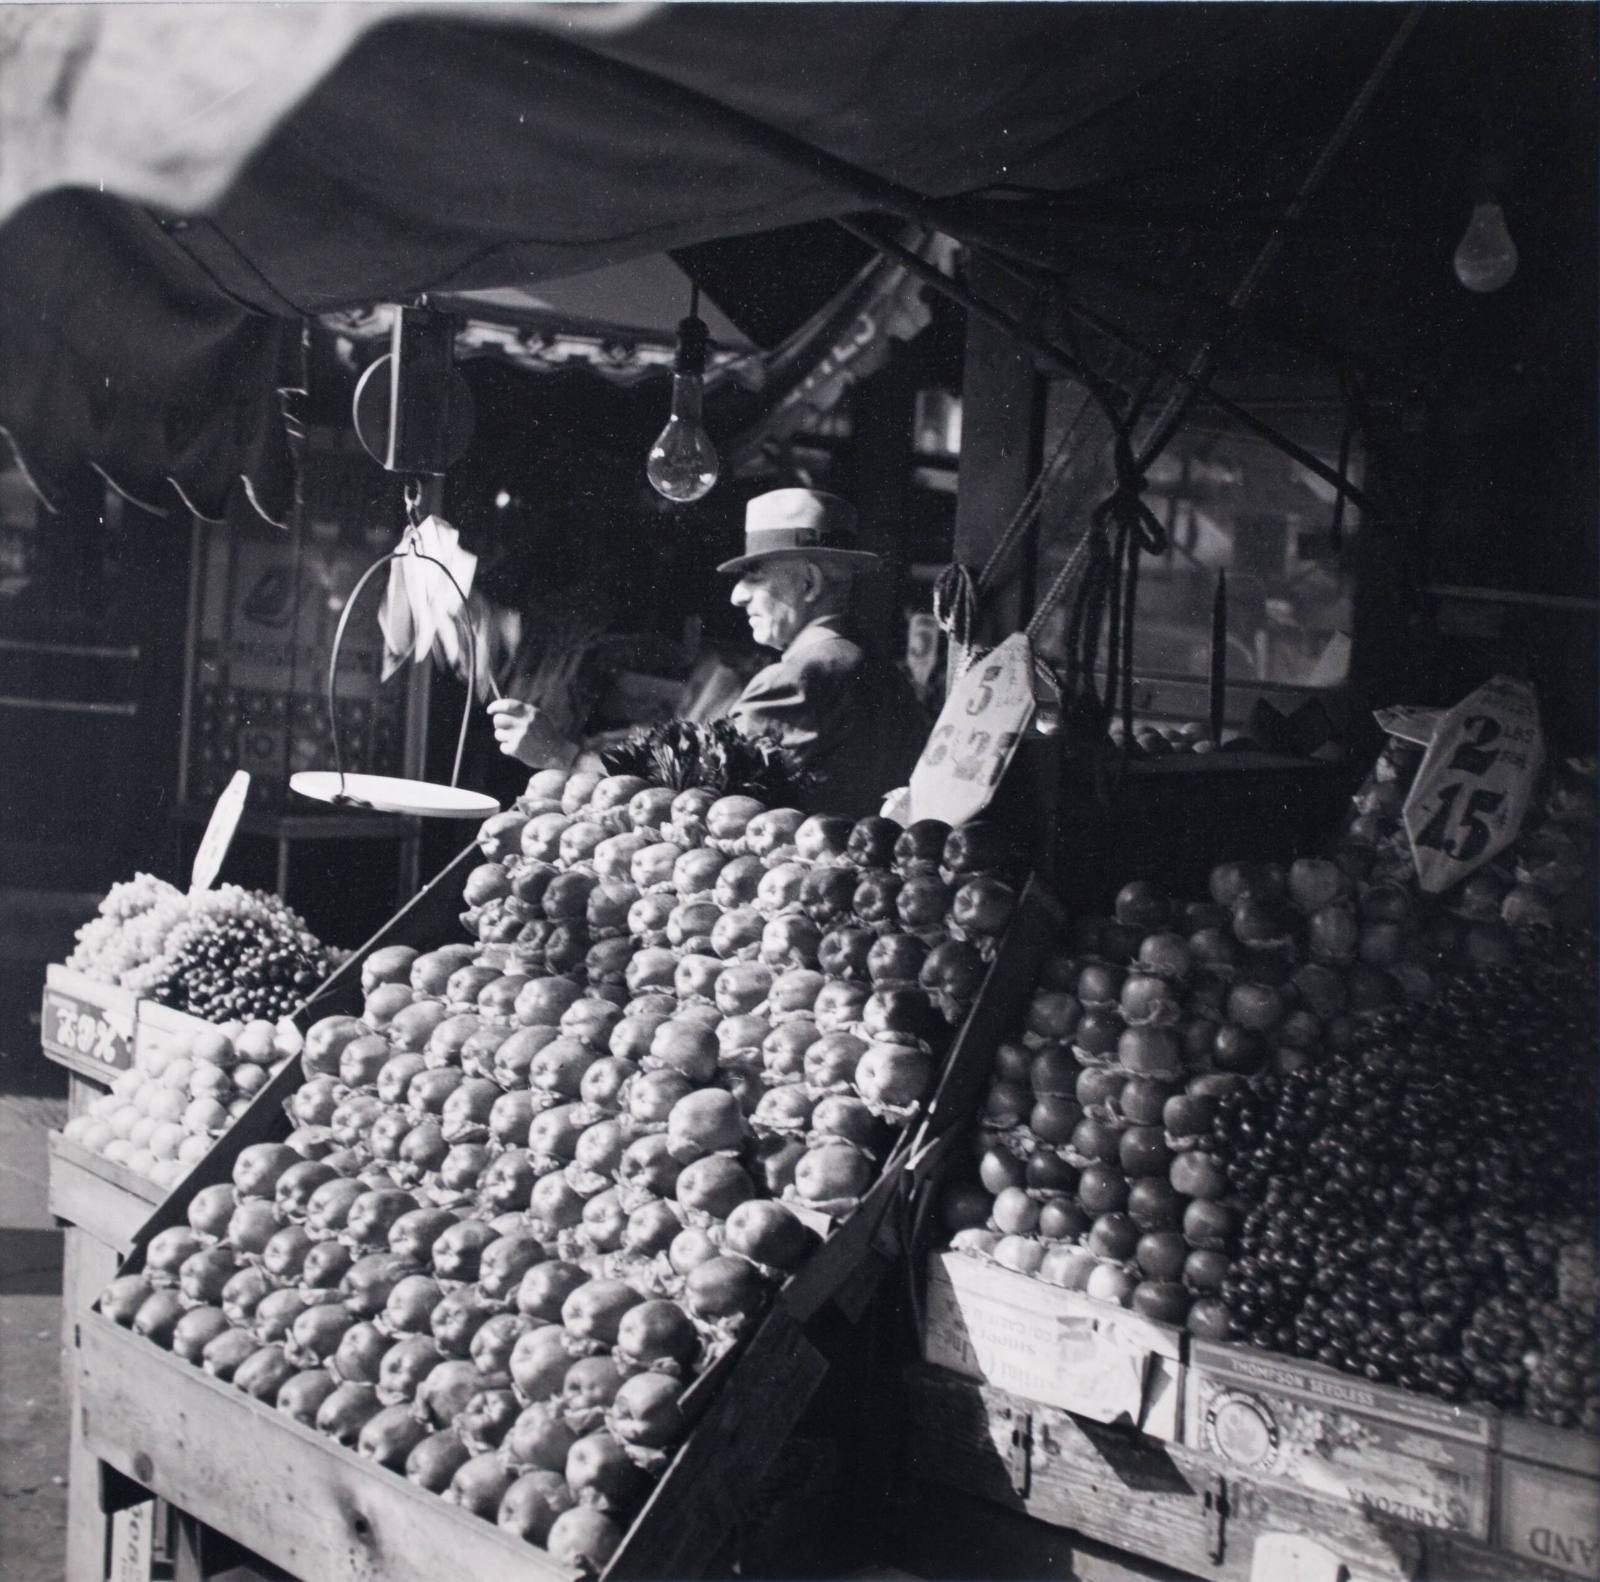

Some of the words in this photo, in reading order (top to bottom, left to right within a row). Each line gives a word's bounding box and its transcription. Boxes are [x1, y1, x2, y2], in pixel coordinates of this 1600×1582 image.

[966, 665, 1003, 716] 5
[1448, 714, 1502, 775] 2
[1415, 783, 1508, 861] 15
[1232, 1359, 1305, 1388] THOMPSON
[1309, 1378, 1375, 1406] SEEDLESS
